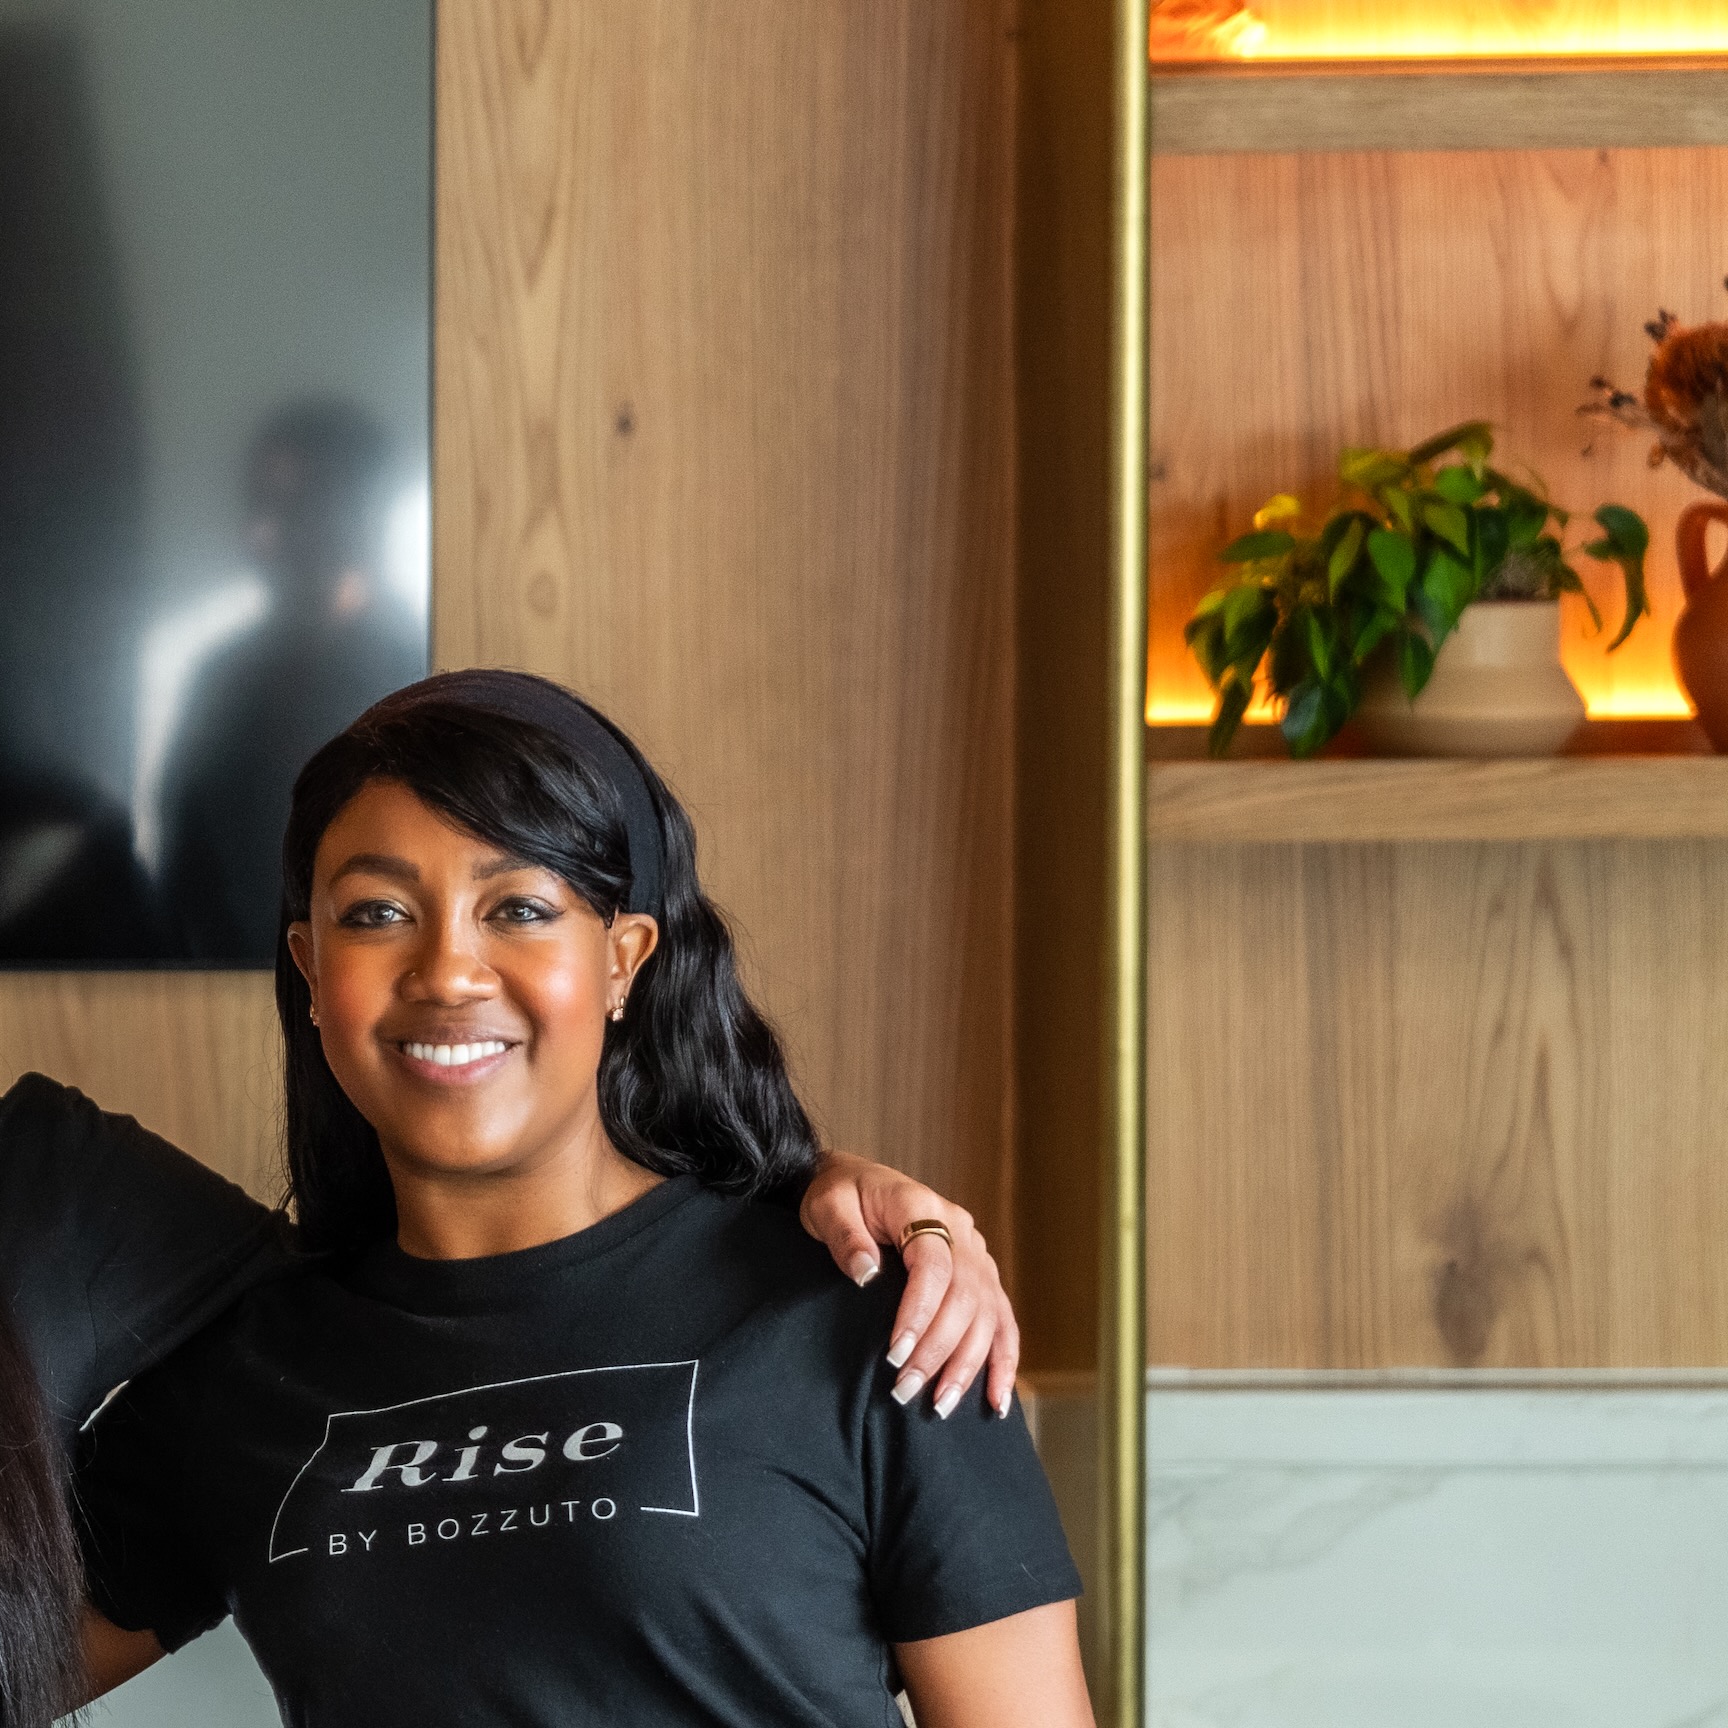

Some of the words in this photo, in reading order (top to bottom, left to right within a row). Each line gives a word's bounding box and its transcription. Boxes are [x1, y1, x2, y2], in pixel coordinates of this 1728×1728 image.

[341, 1421, 623, 1492] Rise
[329, 1530, 377, 1556] BY
[408, 1498, 617, 1545] BOZZUTO
